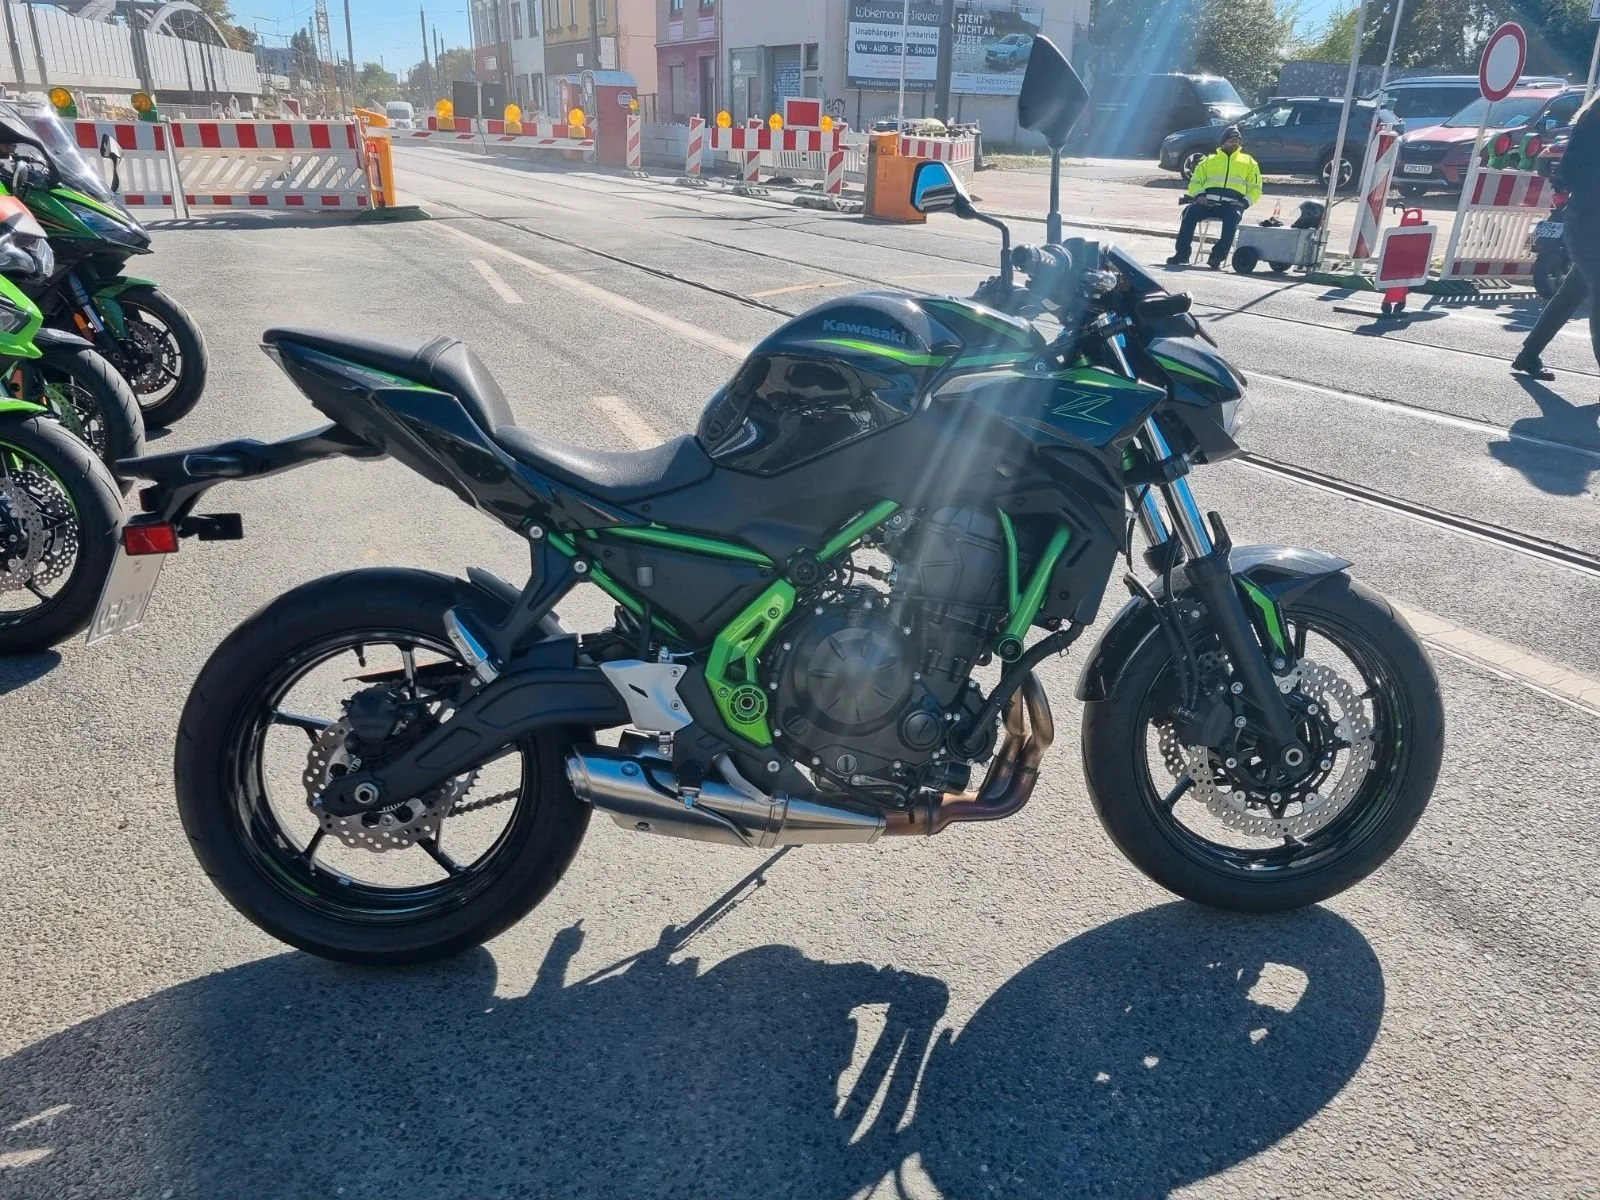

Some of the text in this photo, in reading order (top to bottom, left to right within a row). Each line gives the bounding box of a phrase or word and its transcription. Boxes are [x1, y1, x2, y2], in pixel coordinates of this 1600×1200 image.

[958, 13, 985, 25] STEHT
[855, 27, 900, 39] Unabhängiger
[957, 24, 996, 36] NICHT AN
[956, 34, 982, 45] JEDER
[856, 43, 936, 55] VW AUDI SET ŠKODA
[823, 319, 907, 344] Kawasaki
